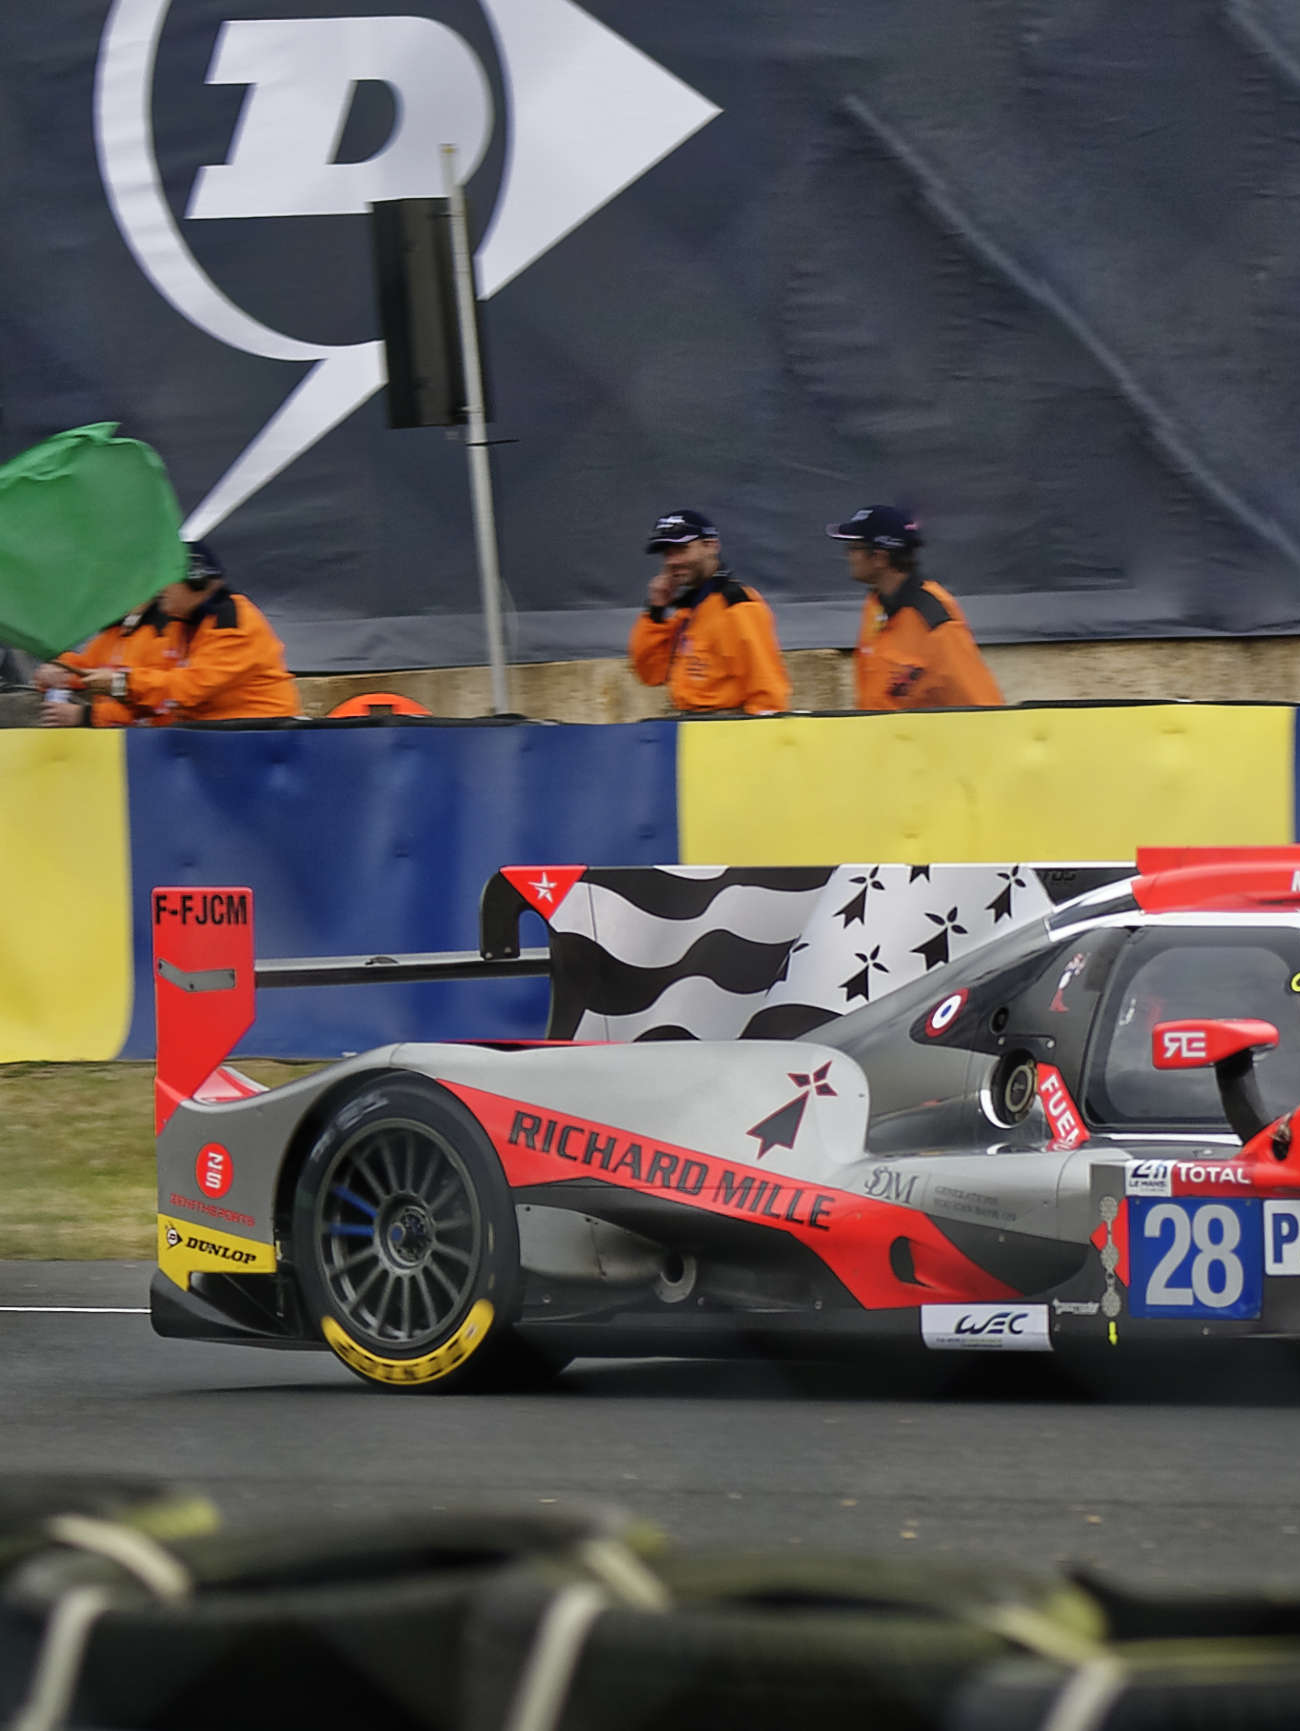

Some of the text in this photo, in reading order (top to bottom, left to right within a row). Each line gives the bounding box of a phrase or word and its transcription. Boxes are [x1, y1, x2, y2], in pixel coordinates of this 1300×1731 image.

[156, 894, 247, 924] F-FJCM
[508, 1110, 835, 1231] RICHARD MILLE
[1176, 1163, 1252, 1184] TOTAL
[186, 1237, 257, 1264] DUNLOP
[1144, 1203, 1245, 1308] 28
[953, 1311, 1030, 1335] WEC
